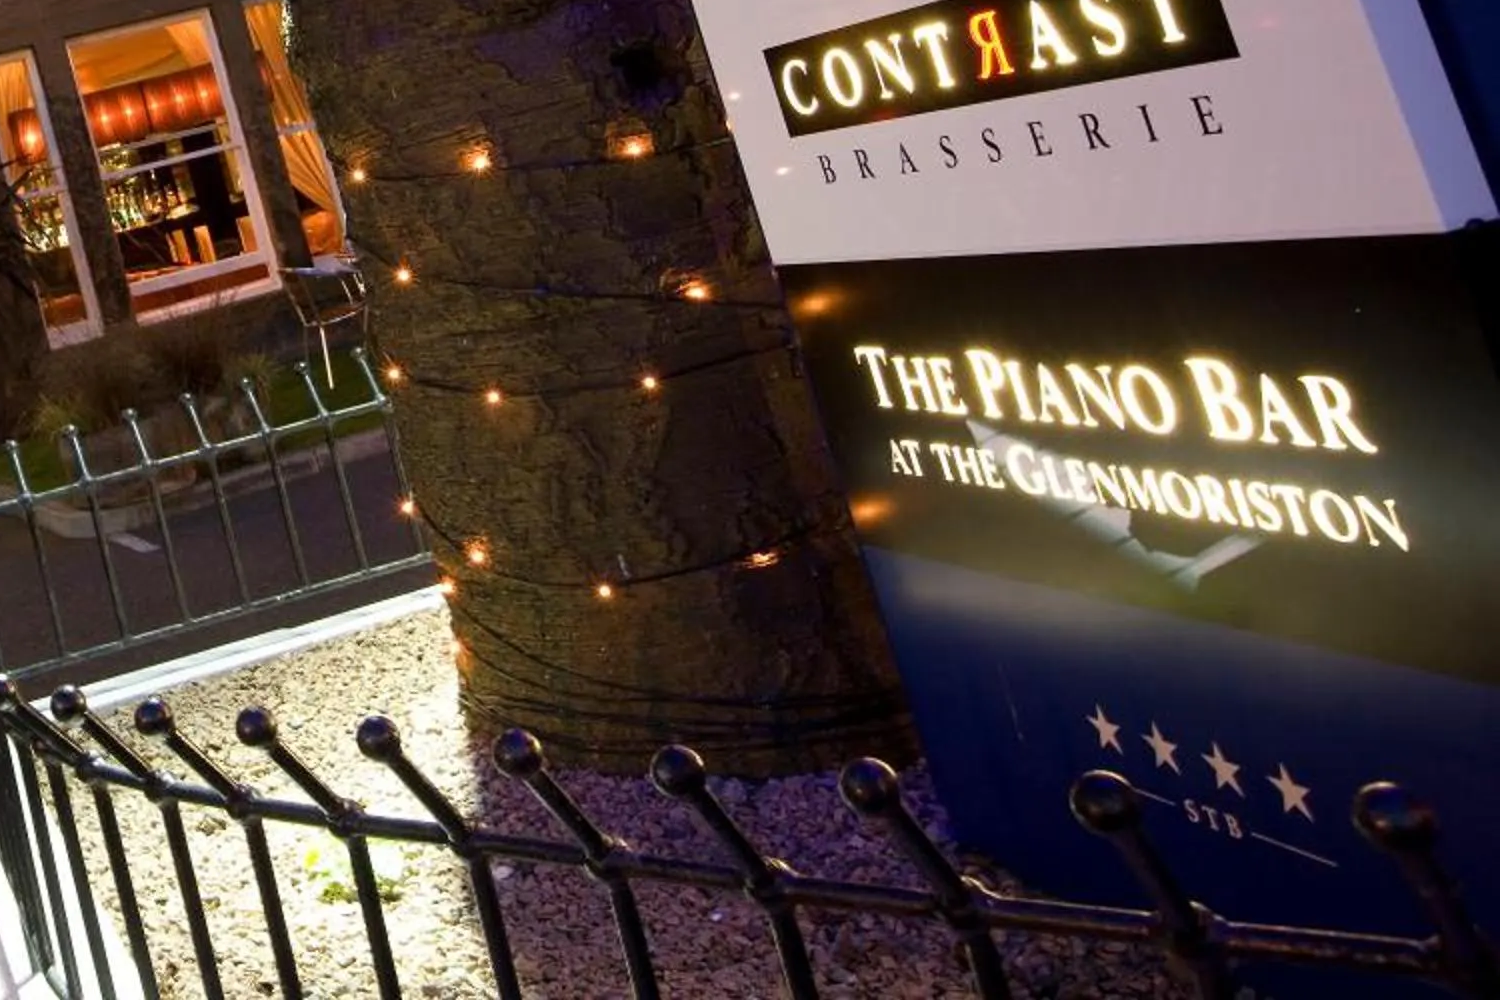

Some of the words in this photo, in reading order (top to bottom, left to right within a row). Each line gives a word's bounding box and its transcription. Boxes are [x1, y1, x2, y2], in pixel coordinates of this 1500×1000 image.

[818, 94, 1224, 185] BRASSERIE
[853, 345, 968, 418] THE
[965, 347, 1179, 437] PIANO
[1184, 357, 1378, 455] BAR
[889, 438, 924, 477] AT
[930, 442, 1006, 490] THE
[1003, 444, 1410, 552] GLENMORISTON
[1183, 799, 1243, 839] STB
